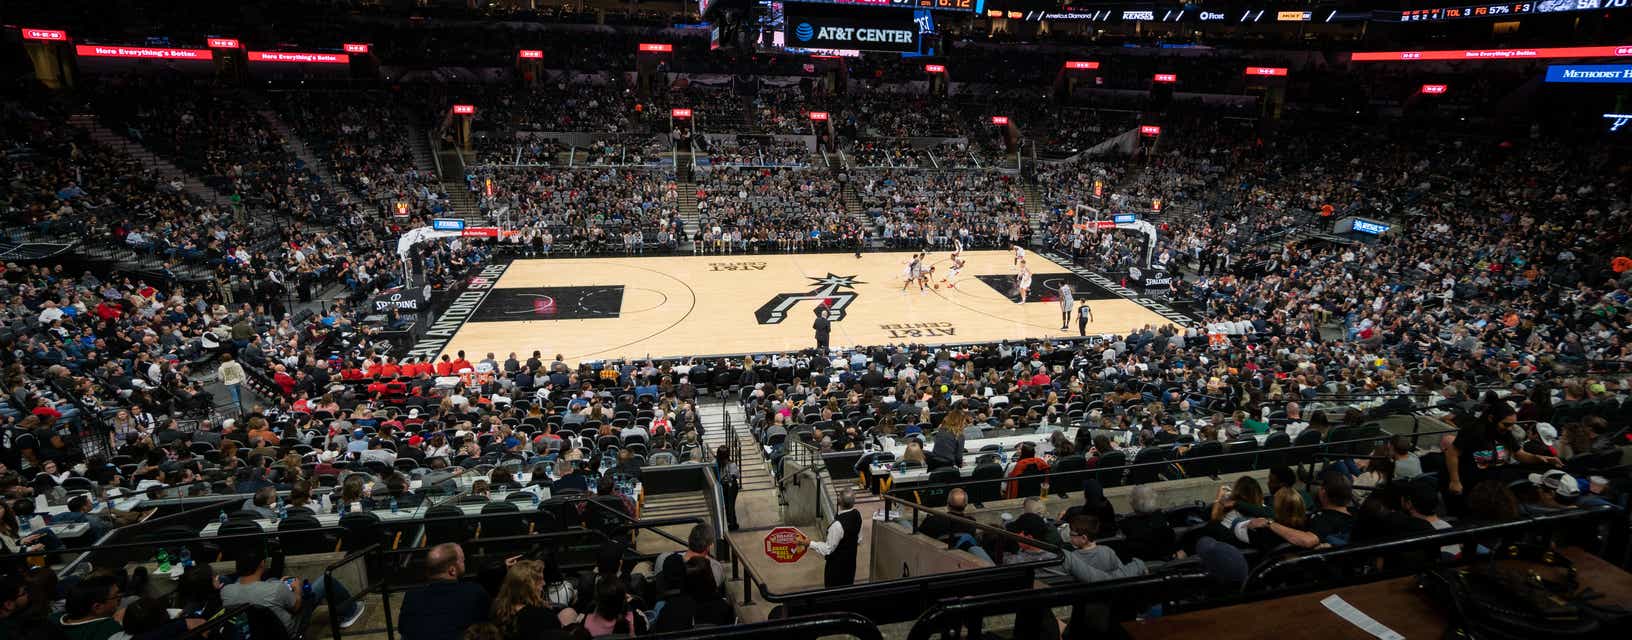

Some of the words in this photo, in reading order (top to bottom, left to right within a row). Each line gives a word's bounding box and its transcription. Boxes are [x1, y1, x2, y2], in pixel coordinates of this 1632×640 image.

[1208, 12, 1225, 20] Frost
[1464, 8, 1471, 16] 3
[1475, 7, 1487, 15] FG
[1489, 5, 1509, 14] 57%
[817, 27, 855, 41] AT&T
[856, 28, 913, 43] CENTER
[425, 290, 486, 336] ANTONIO
[888, 327, 957, 339] AT&T
